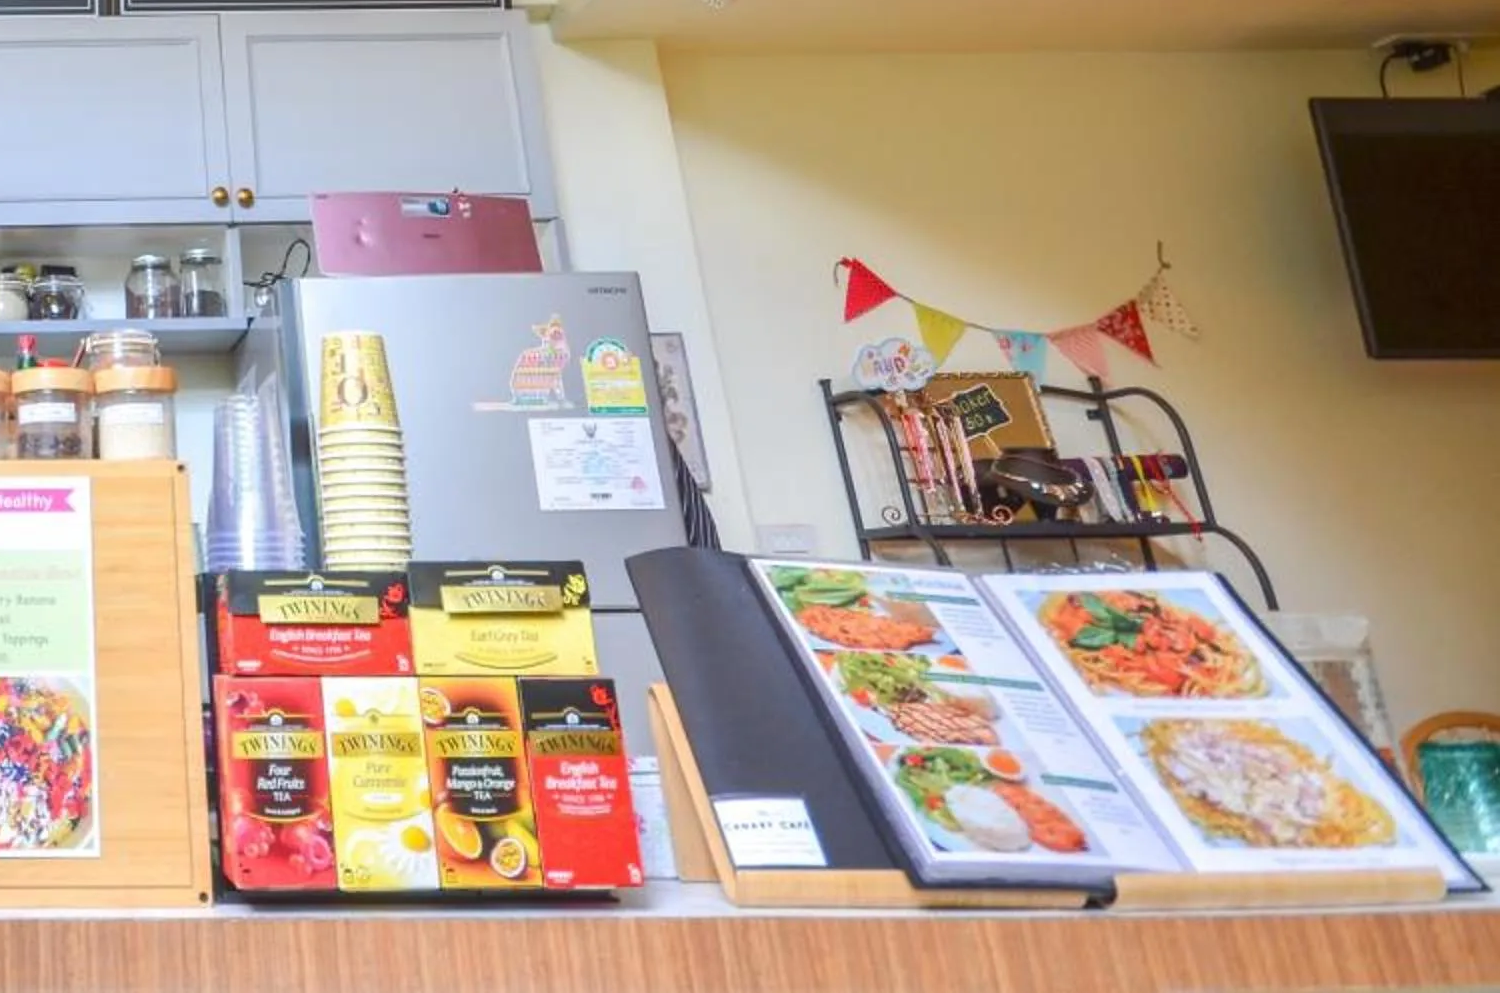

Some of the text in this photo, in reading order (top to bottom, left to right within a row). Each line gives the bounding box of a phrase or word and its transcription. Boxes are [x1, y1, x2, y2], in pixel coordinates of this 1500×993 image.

[462, 589, 546, 608] TWININGS
[277, 598, 361, 620] TWININGS
[241, 734, 317, 755] TWININGS
[338, 734, 415, 756] TWININGS
[436, 734, 517, 754] TWININGS
[537, 735, 617, 755] TWININGS
[268, 764, 293, 776] Four
